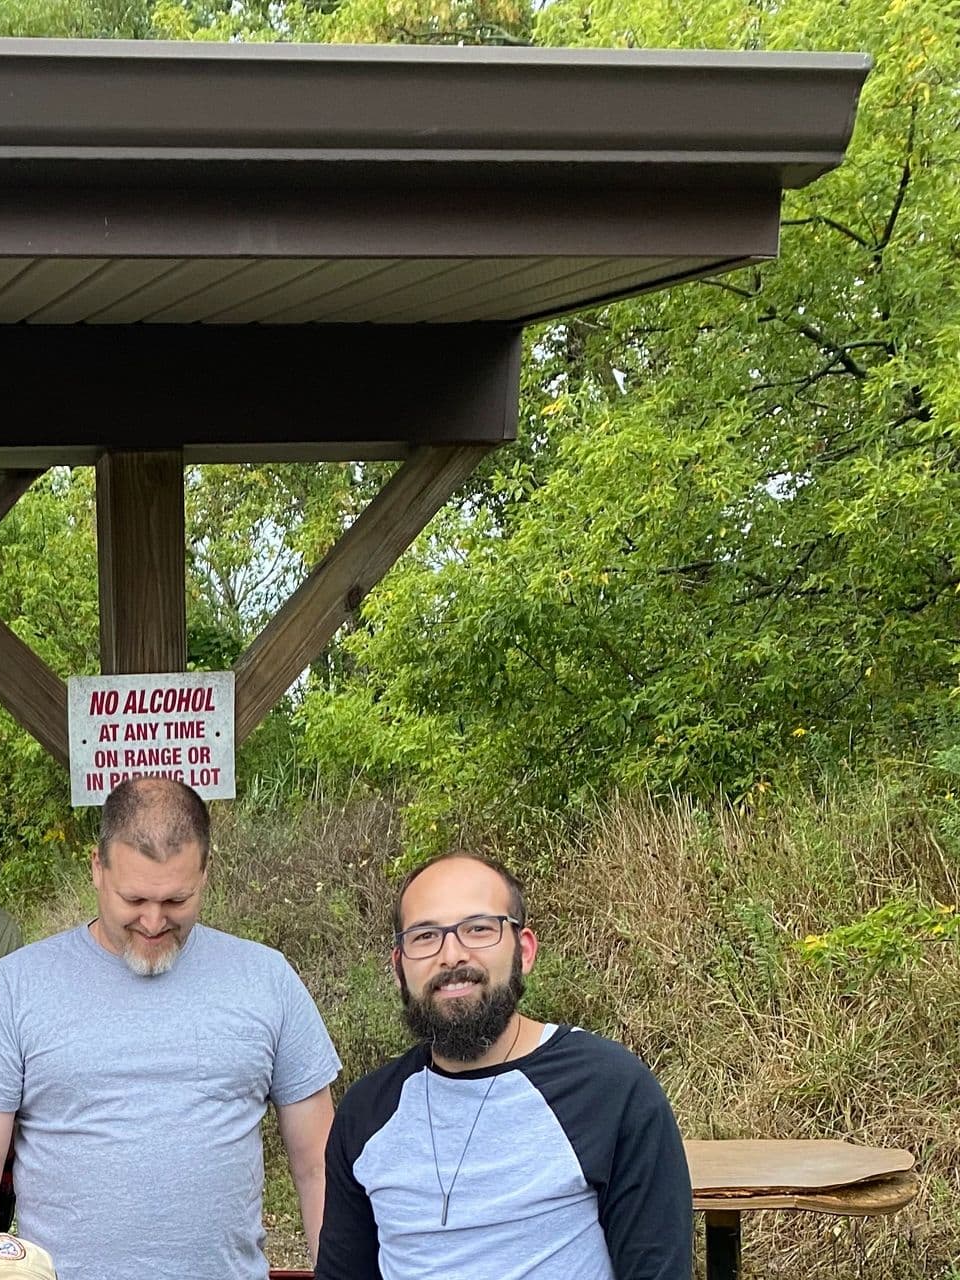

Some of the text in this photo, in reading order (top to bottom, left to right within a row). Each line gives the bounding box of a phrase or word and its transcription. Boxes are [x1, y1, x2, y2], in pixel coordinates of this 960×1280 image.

[90, 688, 215, 715] NO ALCOHOL
[99, 721, 205, 742] AT ANY TIME
[94, 746, 211, 768] ON RANGE OR
[86, 773, 103, 791] IN
[191, 768, 220, 786] LOT
